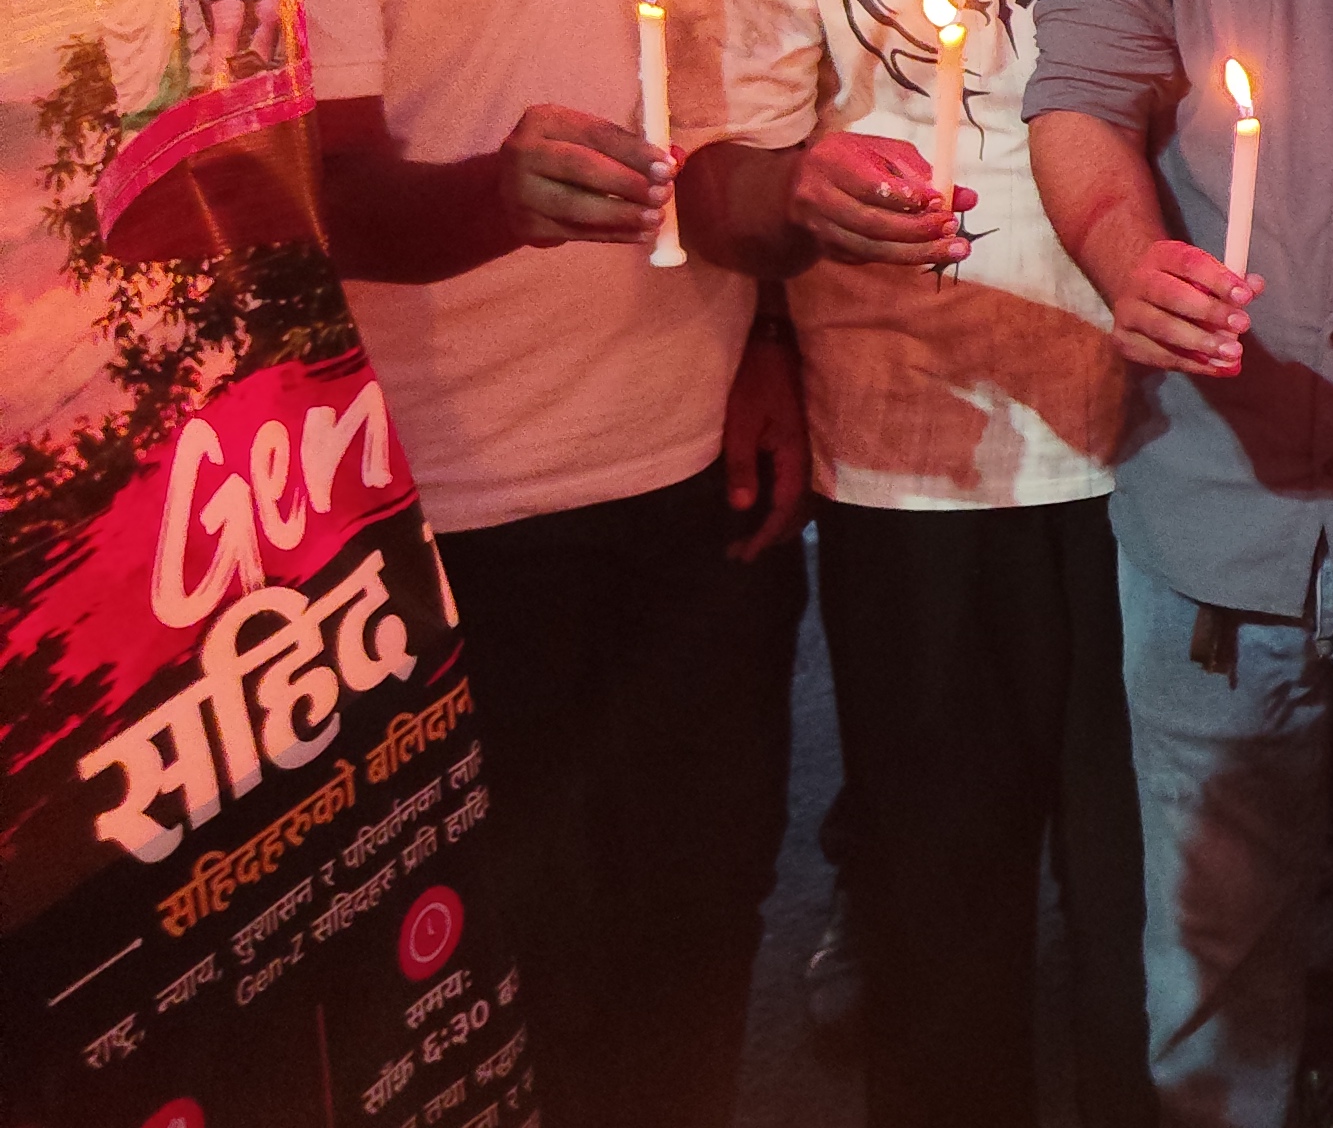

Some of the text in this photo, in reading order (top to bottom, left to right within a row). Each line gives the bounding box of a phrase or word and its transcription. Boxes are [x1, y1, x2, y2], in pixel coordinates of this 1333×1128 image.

[151, 380, 394, 629] Gen
[77, 549, 418, 862] सहिद
[366, 679, 474, 780] बलिदान
[320, 860, 340, 888] र
[402, 826, 439, 877] प्रति
